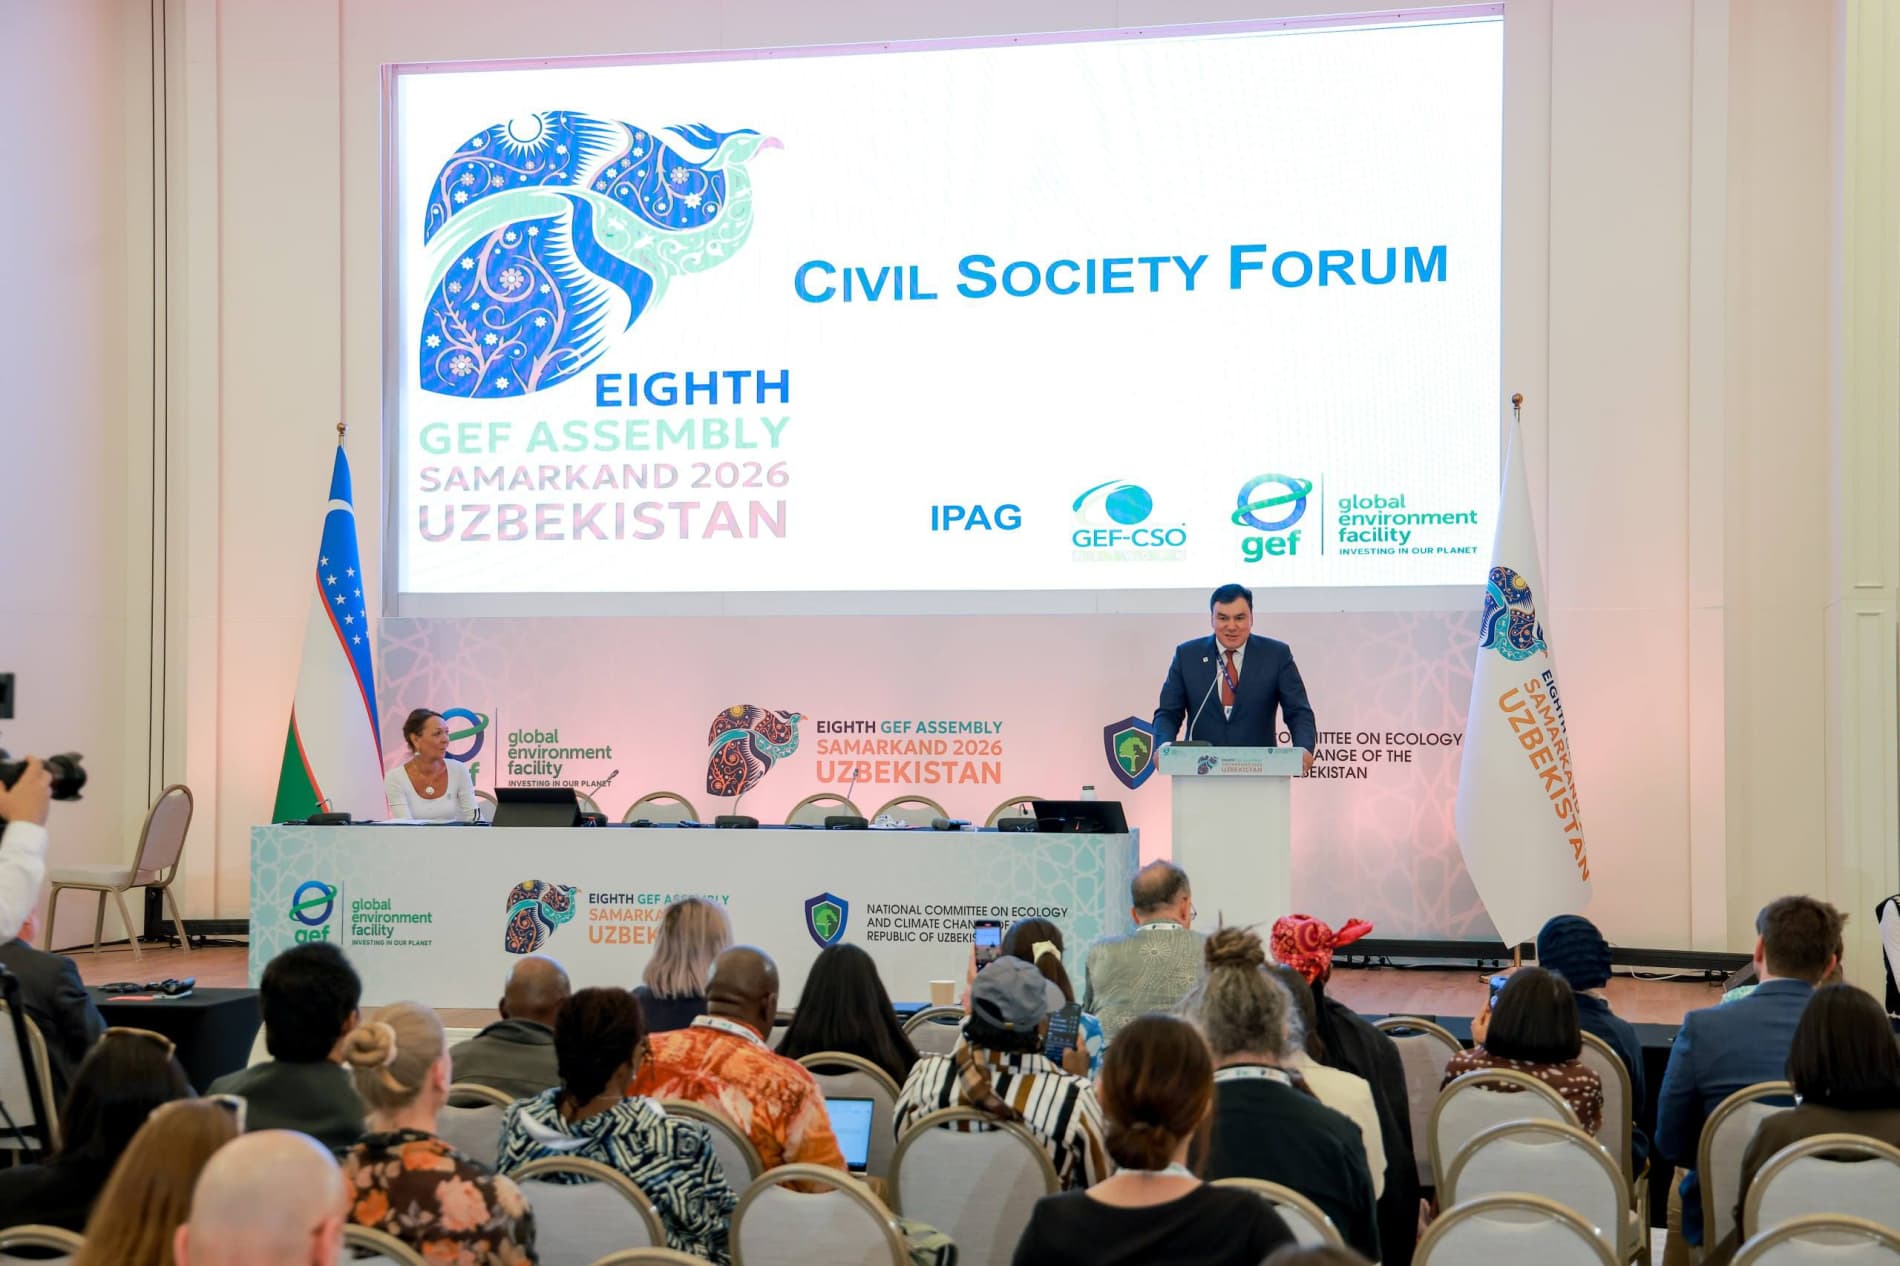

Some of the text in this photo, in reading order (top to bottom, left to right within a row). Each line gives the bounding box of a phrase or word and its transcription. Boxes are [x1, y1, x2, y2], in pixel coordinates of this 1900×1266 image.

[794, 244, 1448, 303] CIVIL SOCIETY FORUM
[595, 369, 790, 408] EIGHTH
[419, 416, 791, 455] GEF ASSEMBLY
[419, 461, 790, 493] SAMARKAND 2026
[1338, 494, 1406, 513] global
[418, 500, 787, 543] UZBEKISTAN
[931, 503, 1022, 532] IPAG
[1338, 510, 1478, 526] environment
[1072, 528, 1187, 547] GEF-CSO
[1338, 527, 1412, 545] facility
[1241, 530, 1302, 563] gef
[1398, 547, 1409, 555] IN
[1412, 547, 1434, 555] OUR
[1436, 546, 1478, 554] PLANET
[816, 720, 1003, 734] EIGHTH GEF ASSEMBLY
[508, 729, 558, 747] global
[1356, 732, 1380, 745] ON
[1385, 732, 1463, 746] ECOLOGY
[508, 745, 612, 759] environment
[816, 739, 1003, 756] SAMARKAND 2026
[1313, 749, 1412, 762] ANGE OF THE
[508, 761, 563, 778] facility
[816, 760, 1002, 785] UZBEKISTAN
[581, 780, 612, 788] PLANET
[1498, 687, 1590, 882] UZBEKISTAN
[351, 898, 391, 913] global
[589, 893, 634, 904] EIGHTH
[637, 893, 661, 905] GEF
[351, 911, 432, 923] environment
[589, 908, 665, 922] SAMARKA
[867, 904, 1068, 918] NATIONAL COMMITTEE ON ECOLOGY
[351, 924, 394, 939] facility
[867, 918, 891, 928] AND
[894, 918, 940, 929] CLIMATE
[943, 919, 976, 929] CHAN
[588, 925, 657, 945] UZBEK
[867, 931, 916, 942] REPUBLIC
[919, 931, 934, 942] OF
